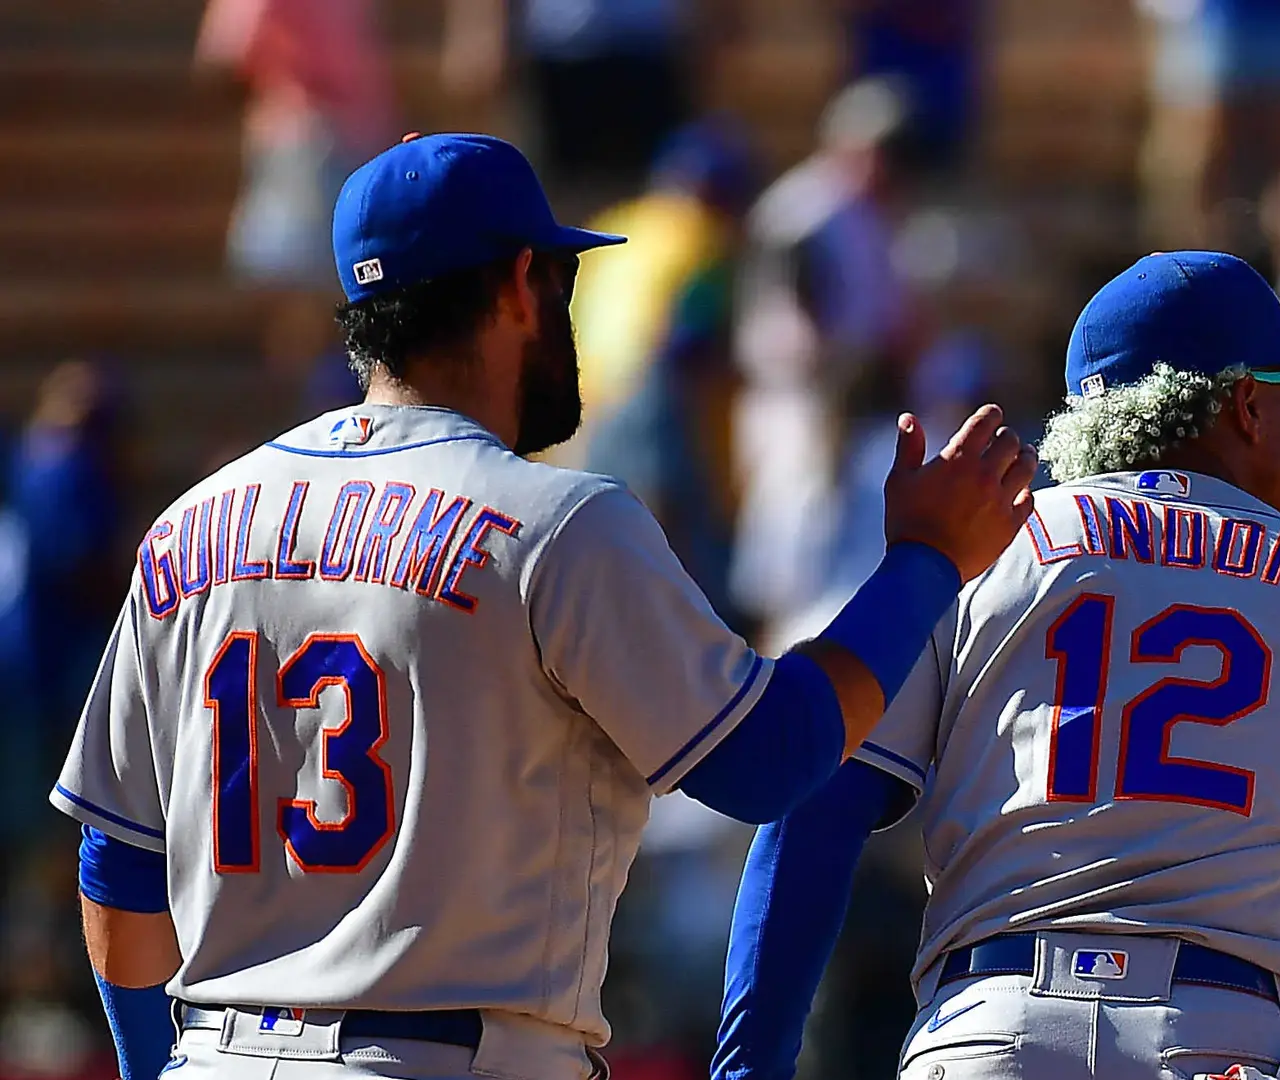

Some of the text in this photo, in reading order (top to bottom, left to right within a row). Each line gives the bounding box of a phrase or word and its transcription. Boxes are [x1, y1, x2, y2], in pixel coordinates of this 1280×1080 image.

[137, 481, 521, 620] GUILLORME
[204, 630, 395, 873] 13
[1045, 592, 1273, 818] 12
